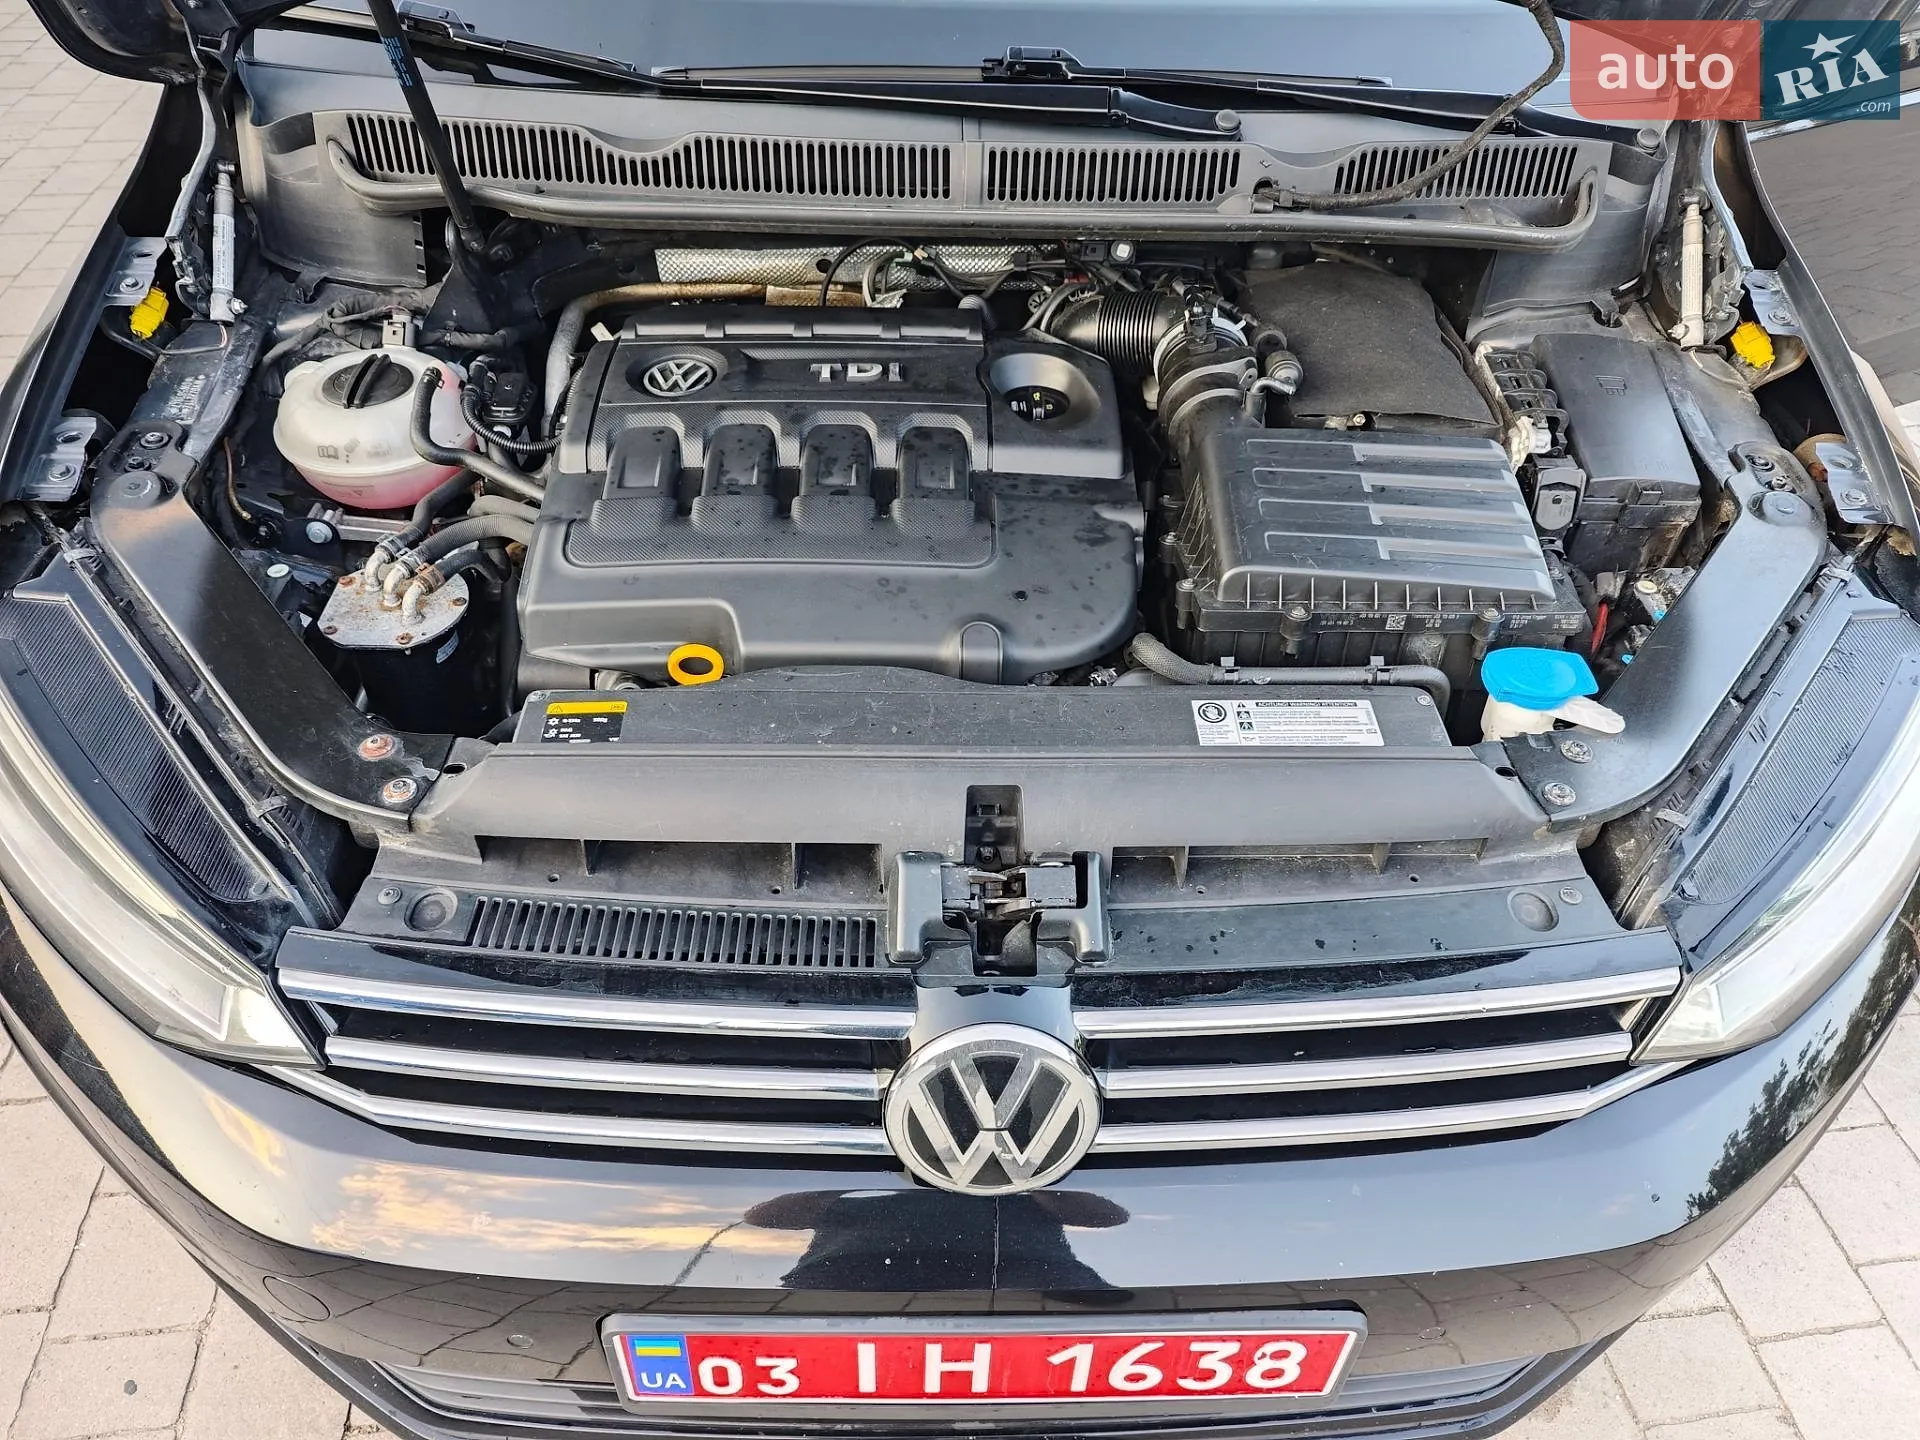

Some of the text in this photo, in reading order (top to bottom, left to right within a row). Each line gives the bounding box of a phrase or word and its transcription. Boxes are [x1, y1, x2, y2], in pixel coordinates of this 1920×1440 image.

[810, 362, 901, 383] TDI
[699, 1355, 800, 1395] 03
[1047, 1340, 1308, 1392] 1638
[641, 1371, 686, 1389] UA
